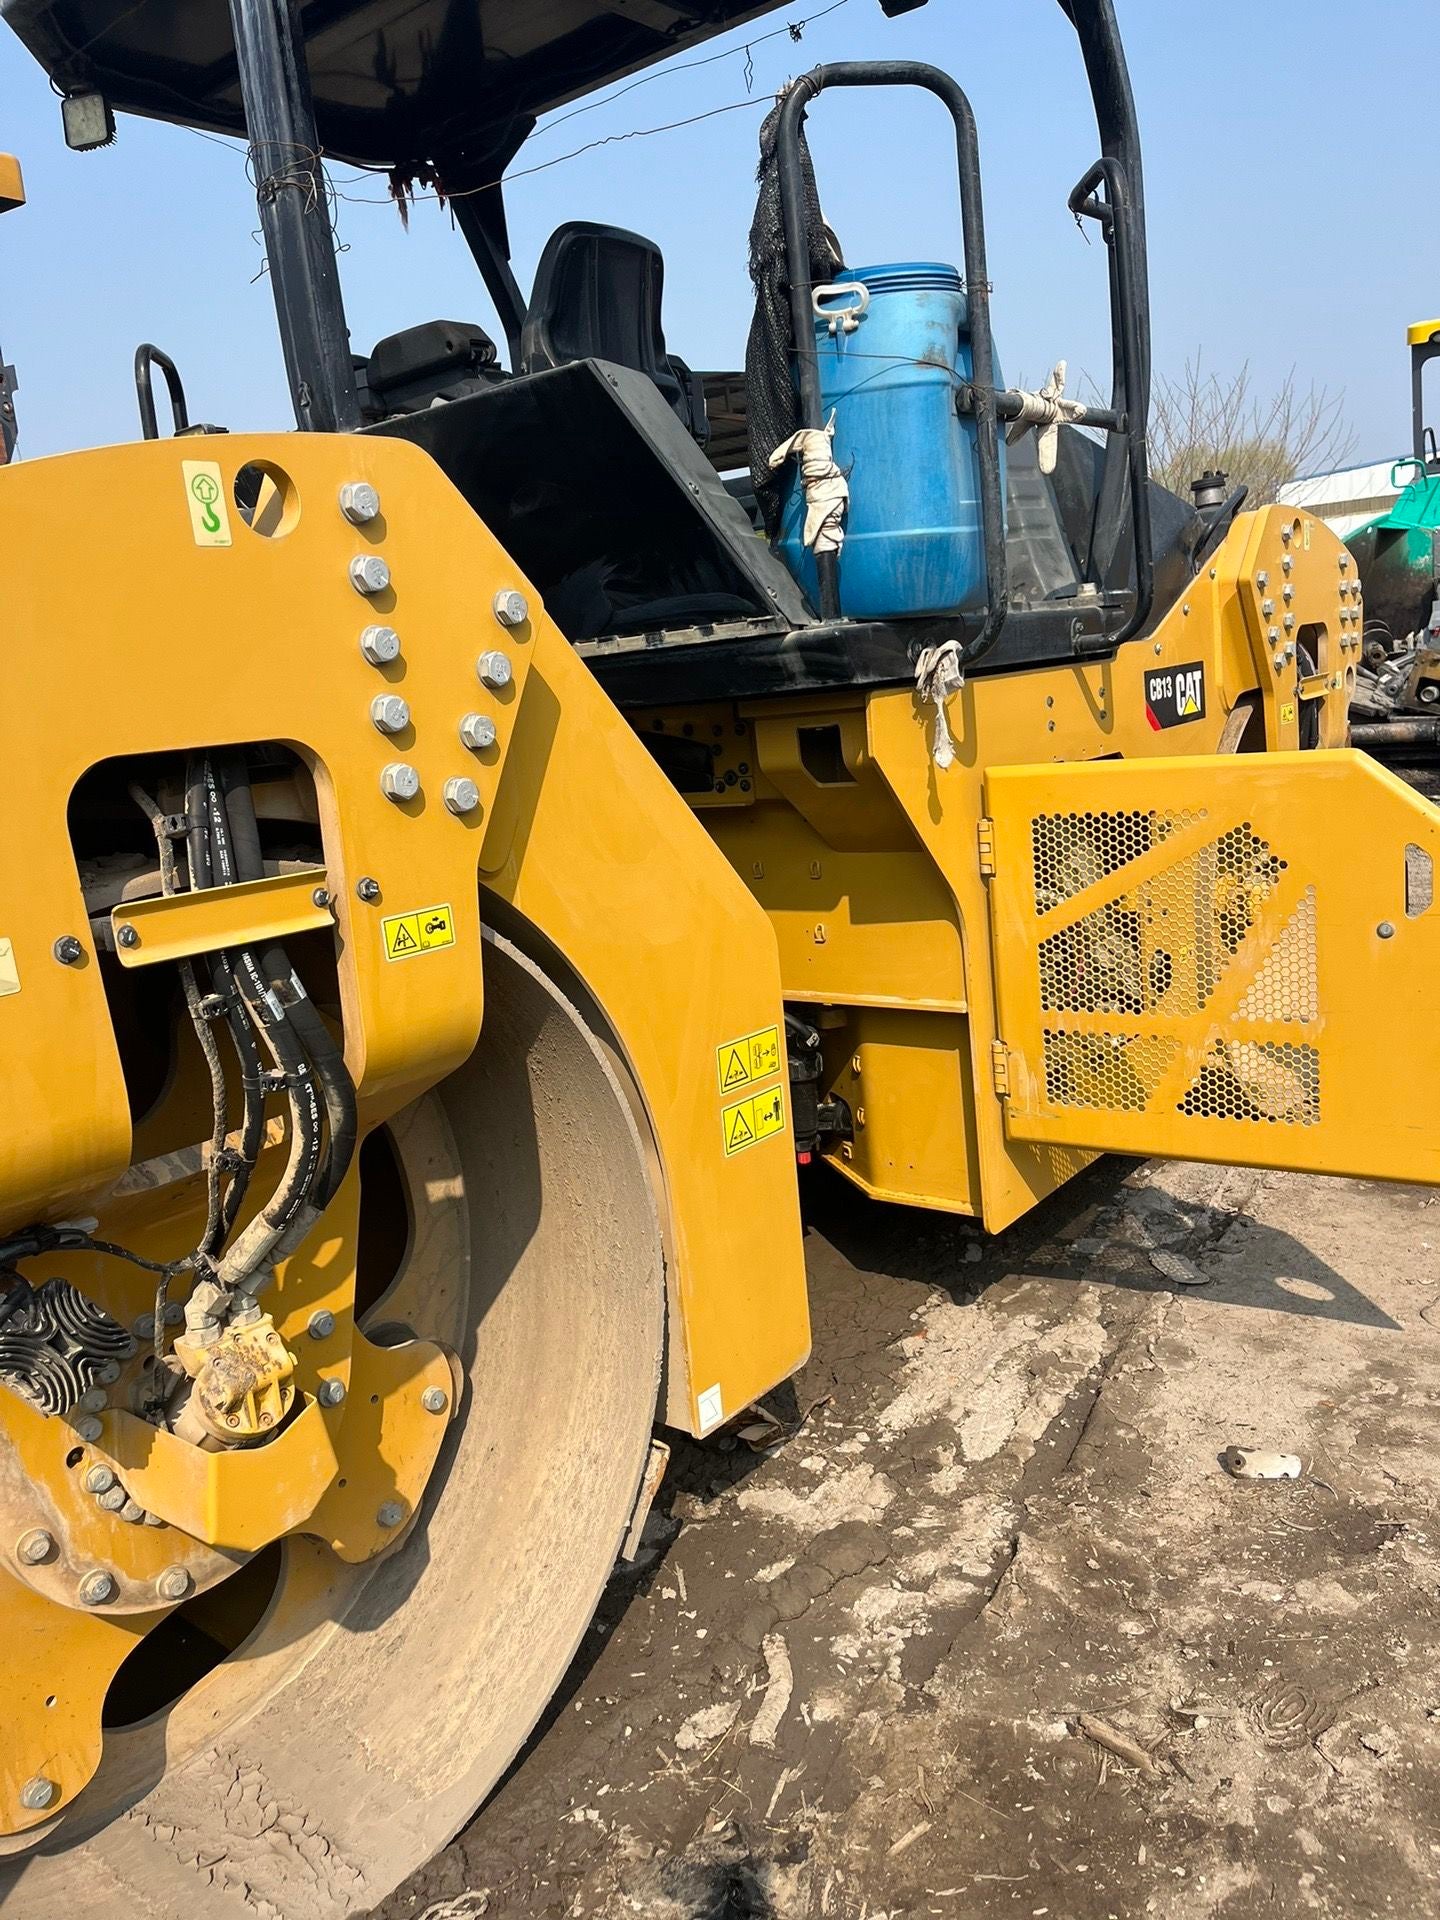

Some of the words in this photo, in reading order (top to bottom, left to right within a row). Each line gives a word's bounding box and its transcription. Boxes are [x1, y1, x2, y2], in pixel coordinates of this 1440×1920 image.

[1150, 676, 1172, 701] CB13
[1175, 670, 1202, 716] CAT
[297, 1063, 307, 1075] CA
